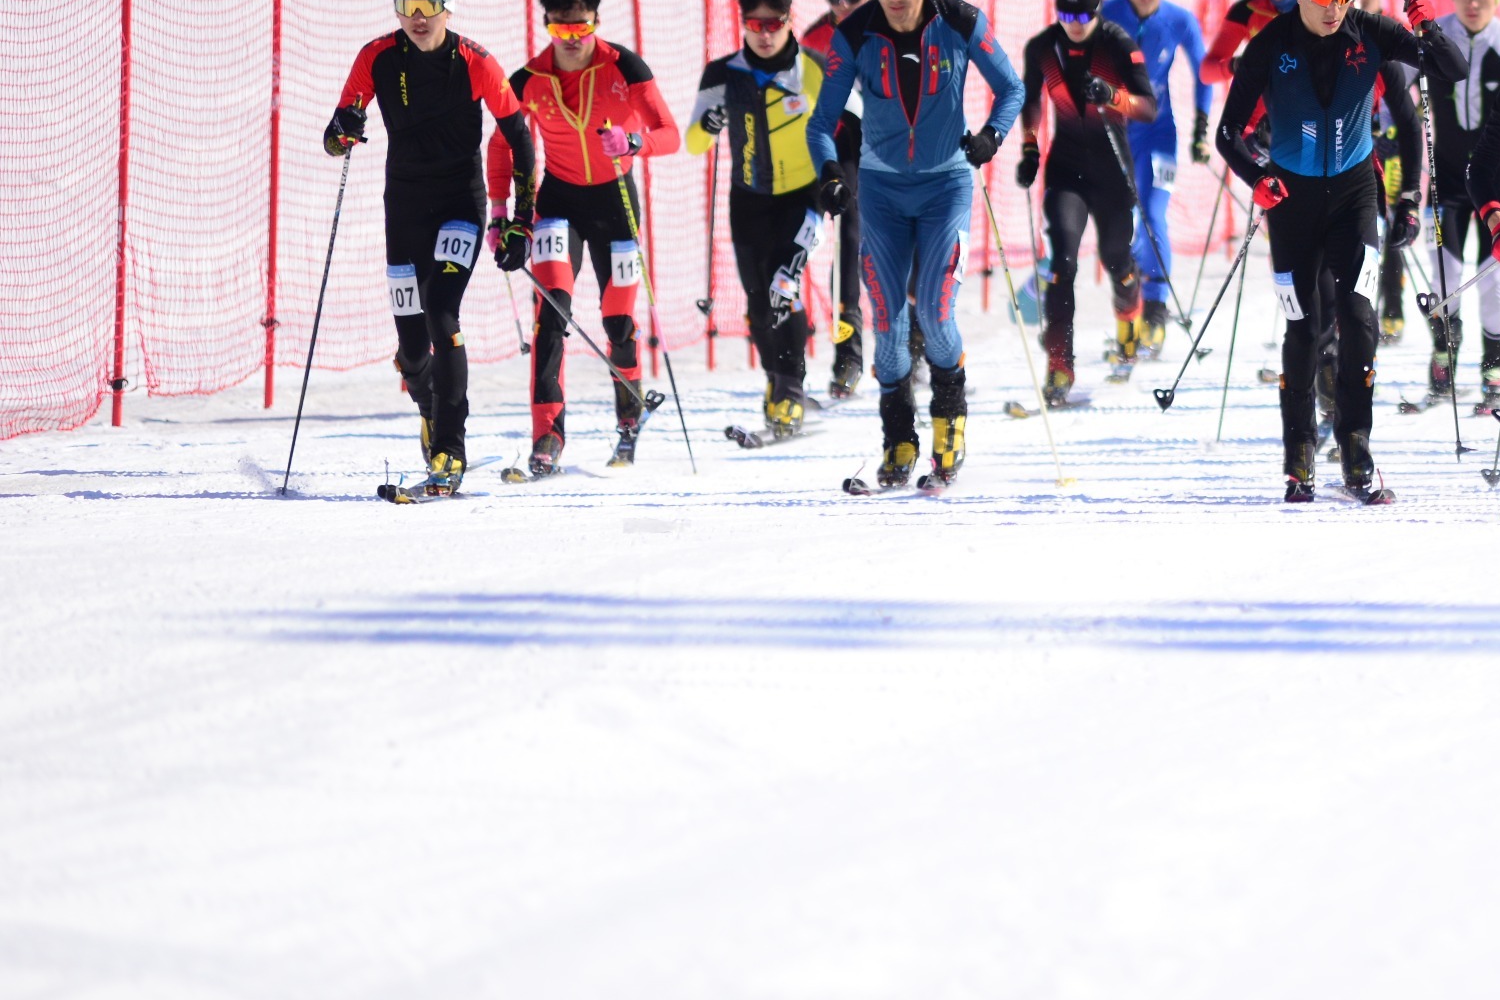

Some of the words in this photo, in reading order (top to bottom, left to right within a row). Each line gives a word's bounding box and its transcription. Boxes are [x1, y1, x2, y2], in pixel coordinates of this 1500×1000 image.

[441, 237, 472, 258] 107
[536, 236, 564, 255] 115
[390, 287, 414, 308] 107
